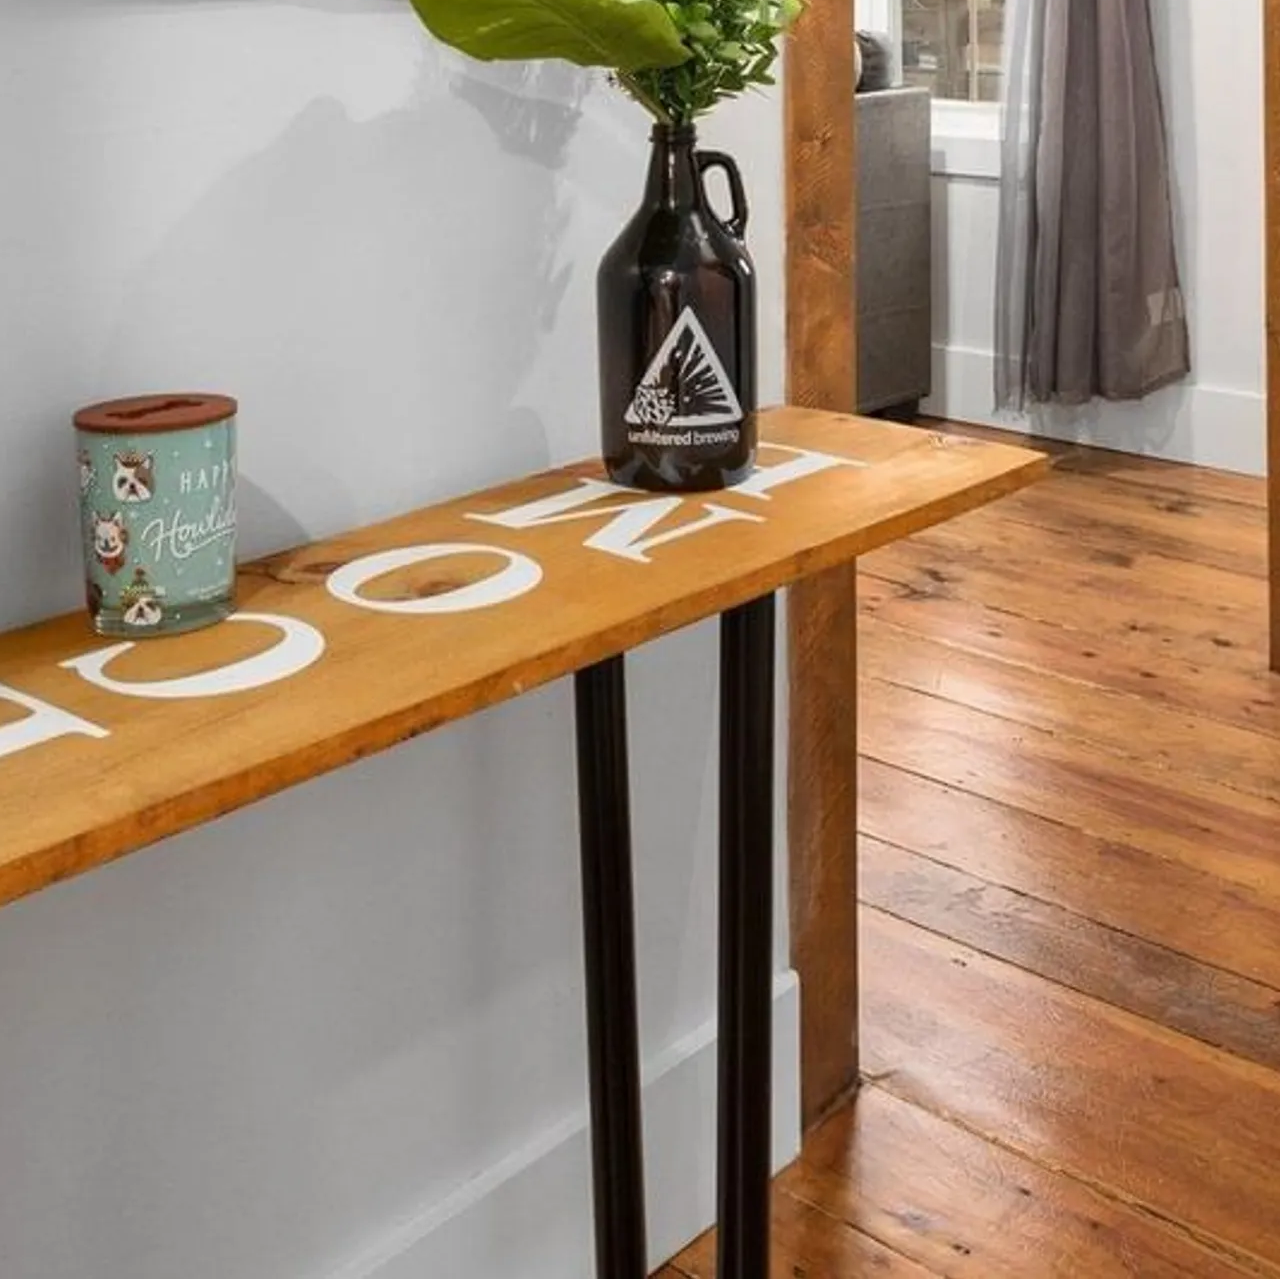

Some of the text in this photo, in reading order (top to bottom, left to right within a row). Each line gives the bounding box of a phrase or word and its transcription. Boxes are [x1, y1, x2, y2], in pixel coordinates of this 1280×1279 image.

[627, 429, 740, 445] unfiltered brewing
[179, 459, 234, 495] HAPP
